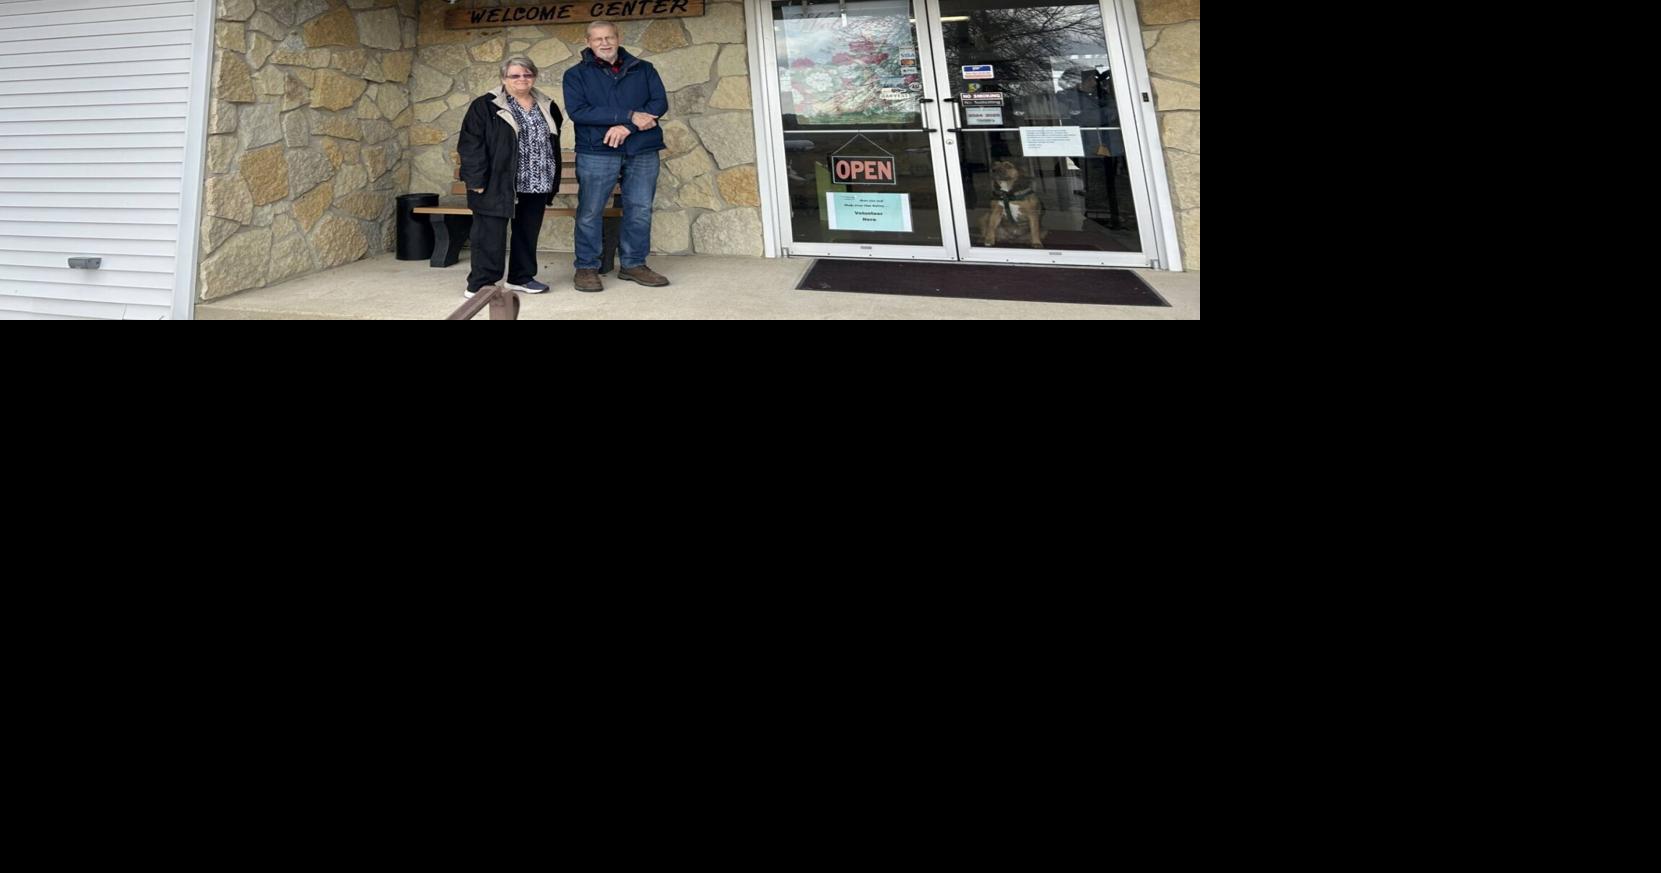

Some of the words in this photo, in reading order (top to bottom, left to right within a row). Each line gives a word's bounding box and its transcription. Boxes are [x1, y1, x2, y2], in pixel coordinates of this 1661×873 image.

[470, 5, 574, 24] WELCOME
[590, 0, 689, 17] CENTER
[835, 160, 892, 180] OPEN
